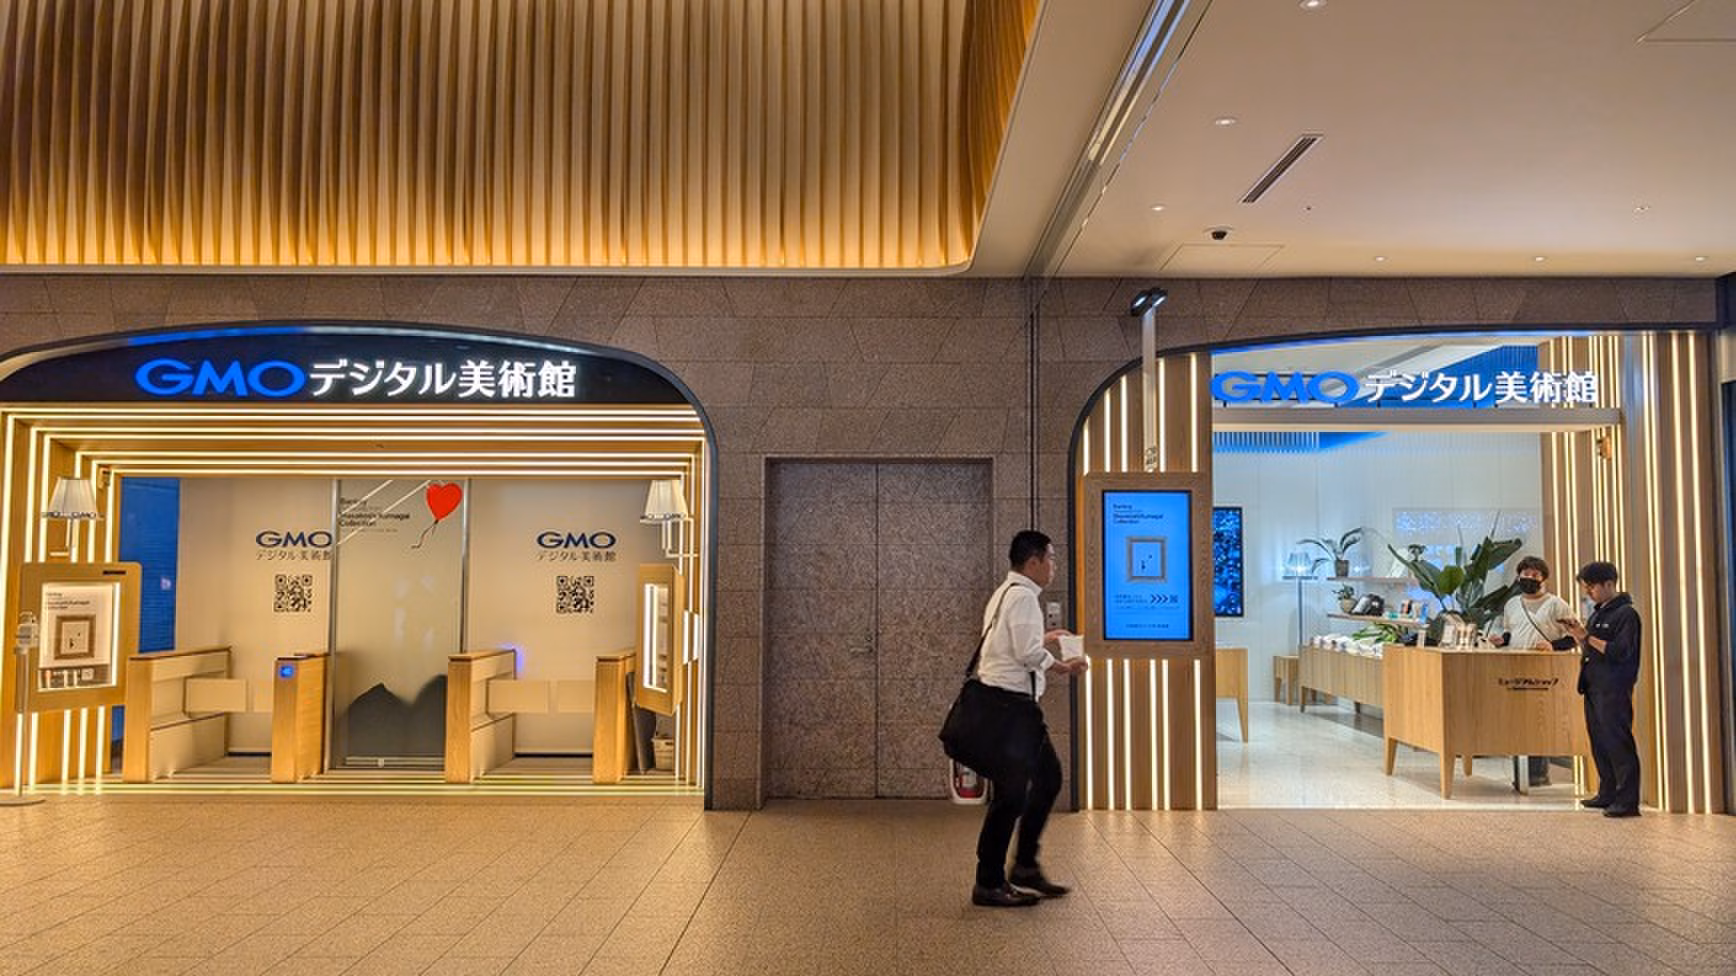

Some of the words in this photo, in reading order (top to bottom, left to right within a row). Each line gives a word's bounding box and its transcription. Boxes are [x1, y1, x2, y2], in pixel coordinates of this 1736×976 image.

[135, 358, 306, 397] GMO
[309, 359, 578, 400] デジタル美術館
[1210, 369, 1360, 405] GMO
[1364, 369, 1598, 404] デジタル美術館
[256, 530, 332, 548] GMO
[537, 531, 616, 549] GMO
